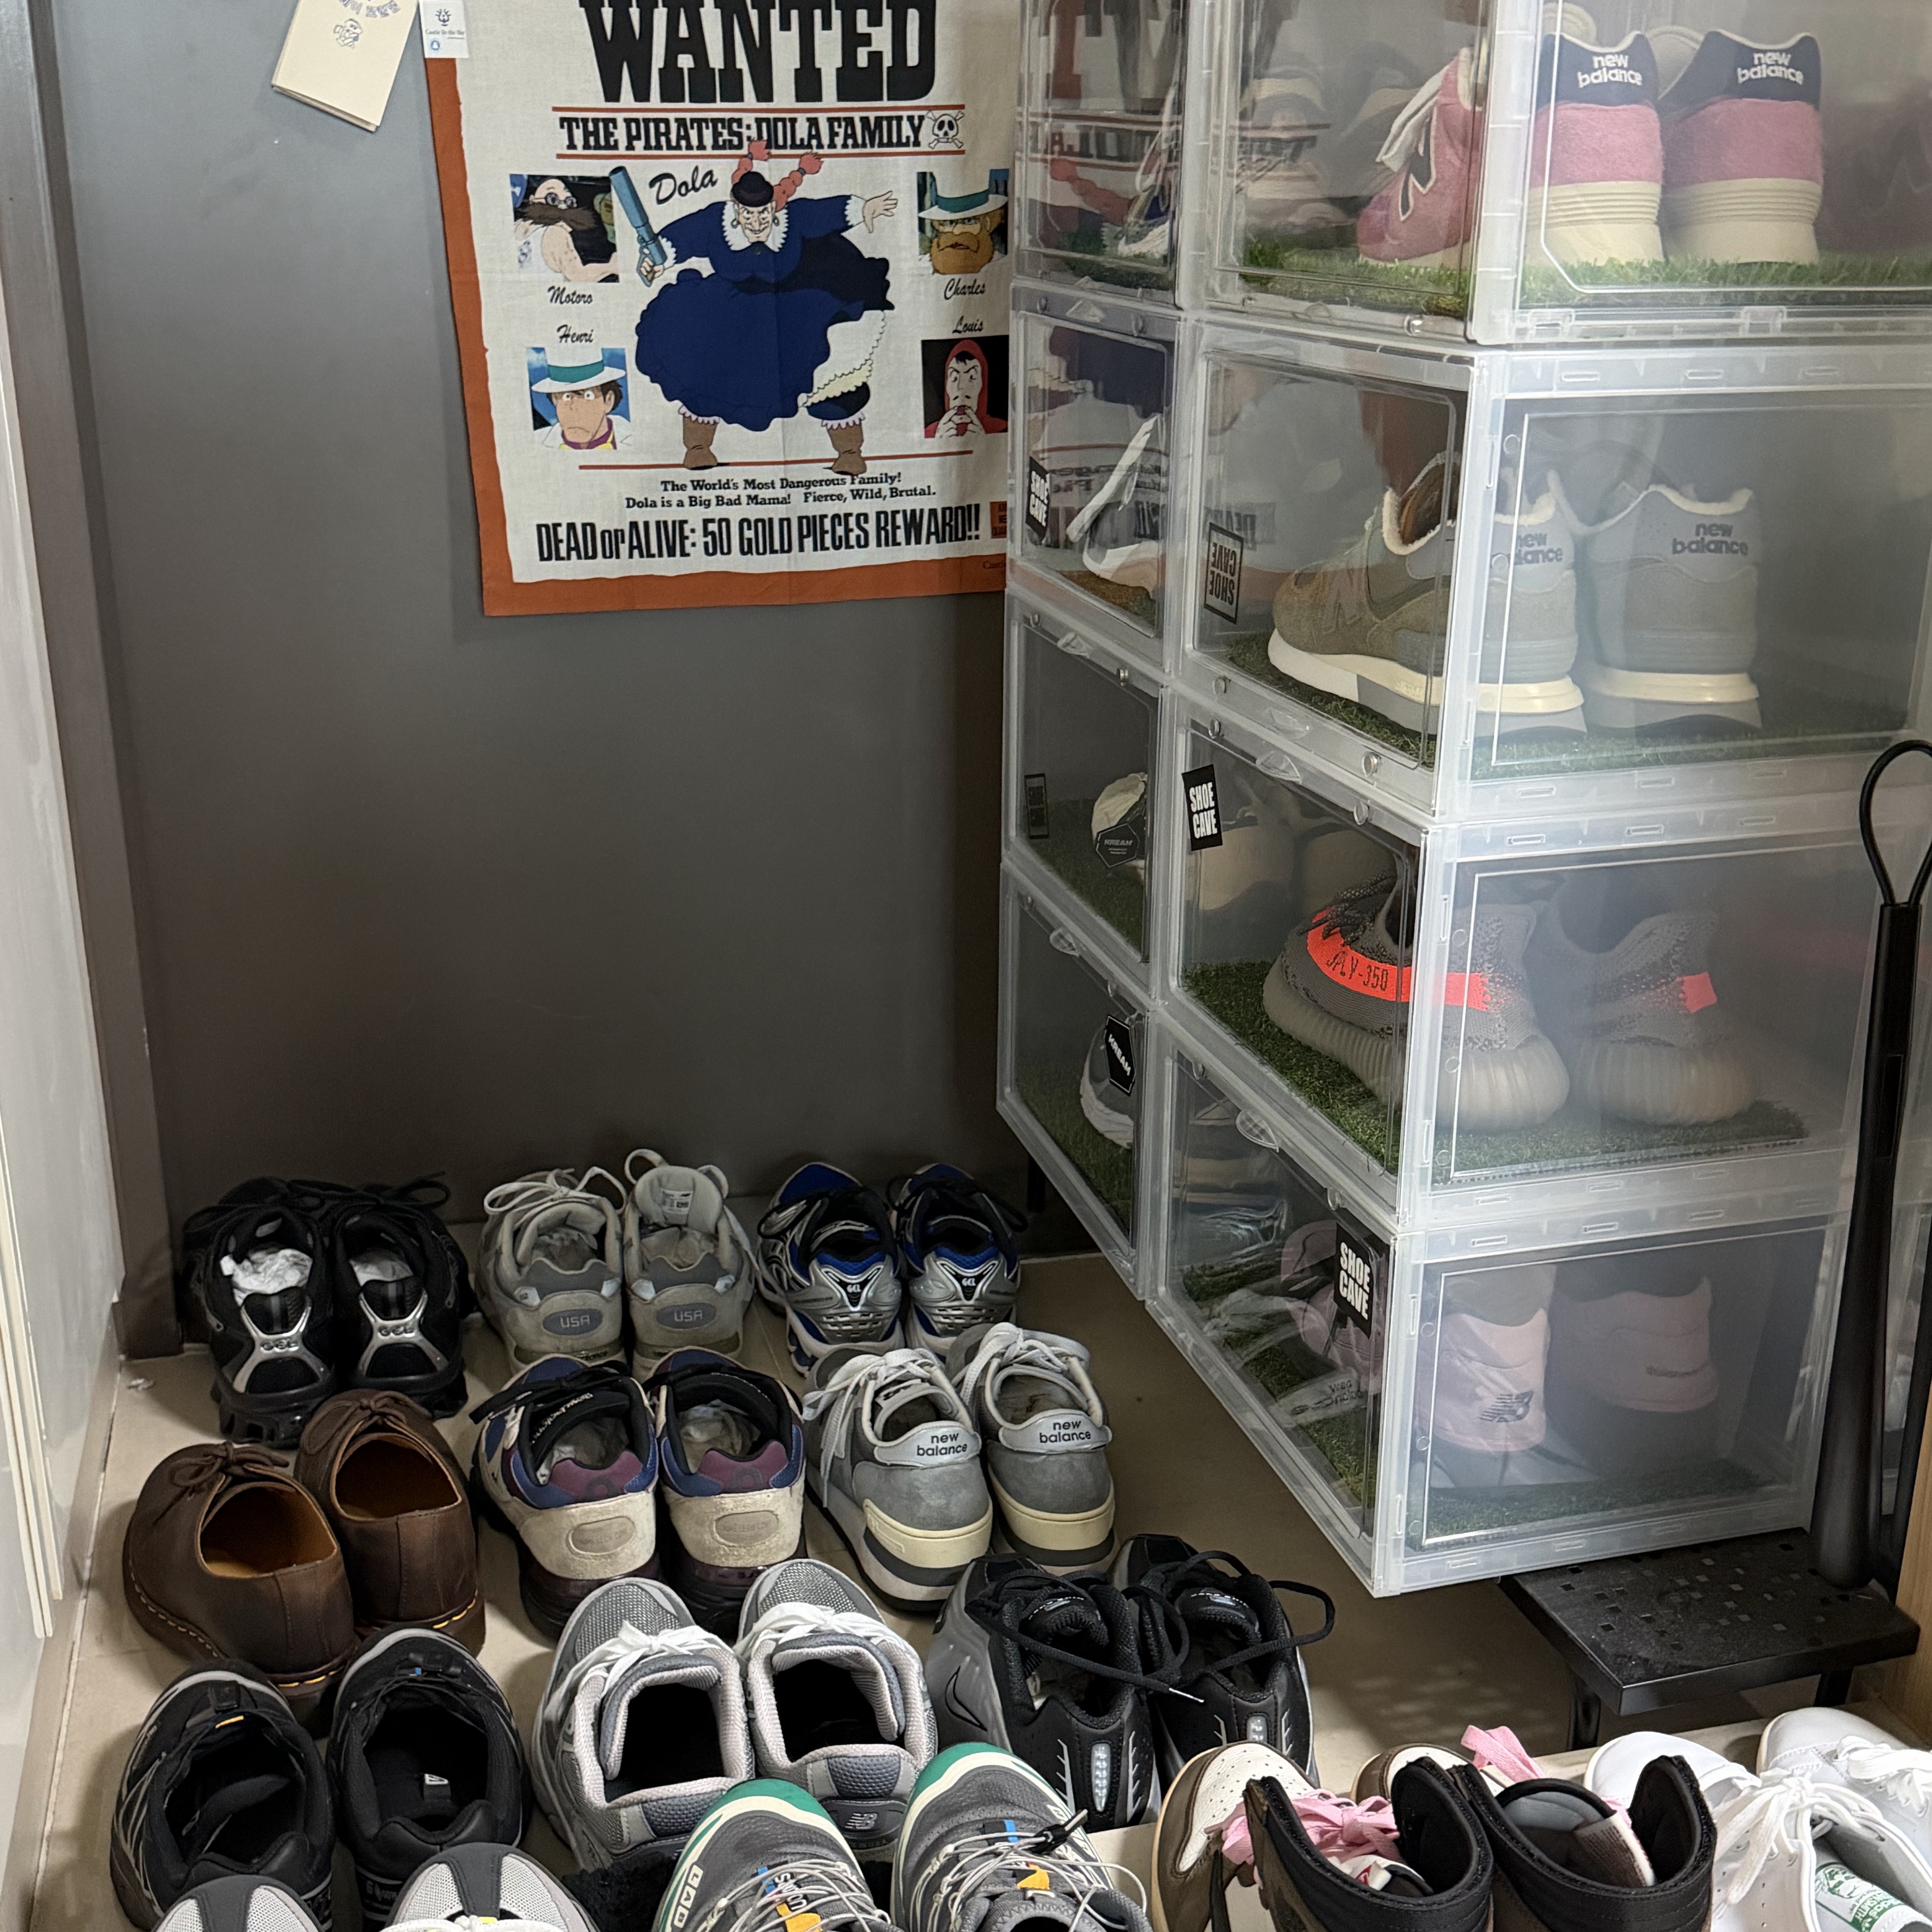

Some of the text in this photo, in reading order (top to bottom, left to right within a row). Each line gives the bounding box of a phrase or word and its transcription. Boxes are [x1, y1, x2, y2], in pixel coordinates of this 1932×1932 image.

[579, 0, 936, 103] WANTED
[1753, 52, 1792, 66] new
[1592, 55, 1629, 68] new
[1578, 72, 1642, 88] balance
[1737, 69, 1803, 86] balance
[559, 117, 618, 151] THE
[827, 115, 925, 149] FAMILY
[649, 165, 718, 205] Dola
[547, 285, 593, 305] Motoro
[944, 279, 985, 300] Charles
[557, 325, 593, 343] Henri
[952, 316, 983, 334] Louis
[661, 472, 901, 492] The World's Most Dangerous Family!
[1031, 471, 1048, 504] SHOE
[626, 486, 936, 509] Dola is a Big Bad Mama! Fierce, Wild, Brutal.
[1030, 494, 1047, 527] CAVE
[536, 503, 980, 561] DEAD or ALIVE: 50 GOLD PIECES REWARD!!
[1695, 523, 1732, 538] new
[1672, 538, 1748, 555] balance
[1189, 782, 1215, 812] SHOE
[1192, 809, 1218, 839] CAVE
[1339, 1242, 1370, 1292] SHOE
[847, 1285, 860, 1293] GEL
[1339, 1274, 1369, 1320] CAVE
[561, 1315, 590, 1328] USA
[674, 1310, 703, 1323] USA
[1053, 1421, 1081, 1431] new
[931, 1433, 959, 1443] new
[1040, 1431, 1091, 1444] balance
[916, 1443, 967, 1456] balance
